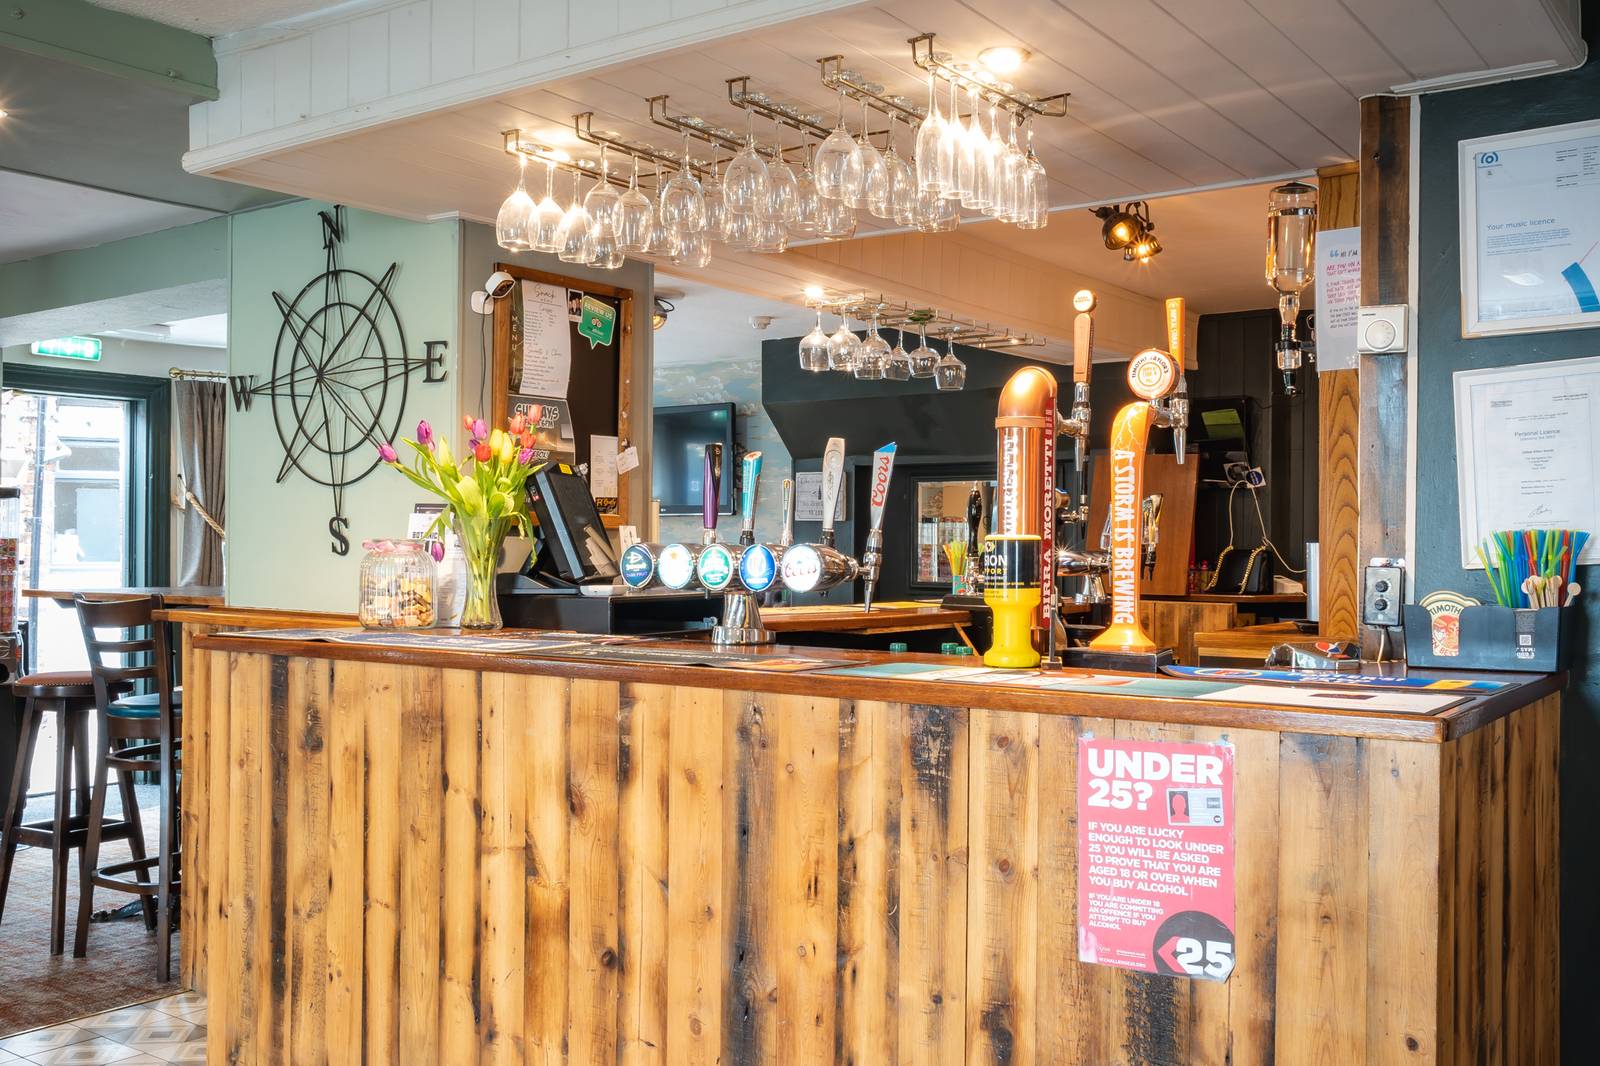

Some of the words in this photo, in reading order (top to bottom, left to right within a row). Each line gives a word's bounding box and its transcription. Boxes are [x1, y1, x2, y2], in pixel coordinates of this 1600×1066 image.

[318, 204, 343, 250] N
[1505, 221, 1527, 229] music
[1529, 217, 1555, 226] licence
[584, 302, 604, 316] REVIEW
[605, 311, 613, 320] US
[423, 341, 448, 383] E
[229, 376, 253, 412] W
[515, 403, 559, 421] SUAYS
[871, 455, 890, 508] Coors
[1043, 438, 1053, 541] MORETTI
[1114, 462, 1136, 522] STORM
[329, 516, 349, 556] S
[412, 531, 438, 539] BOTIC
[1114, 527, 1135, 543] IS
[1043, 548, 1052, 619] BIRRA
[1113, 548, 1135, 624] BREWING
[1429, 604, 1462, 616] TIMOTH
[1088, 748, 1224, 785] UNDER
[1088, 778, 1153, 811] 25?
[1088, 821, 1098, 830] IF
[1100, 822, 1122, 833] YOU
[1124, 825, 1146, 835] ARE
[1148, 827, 1184, 839] LUCKY
[1088, 832, 1133, 845] ENOUGH
[1135, 836, 1150, 847] TO
[1152, 838, 1182, 850] LOOK
[1185, 841, 1224, 854] UNDER
[1088, 843, 1101, 853] 25
[1103, 844, 1125, 855] YOU
[1127, 847, 1154, 858] WILL
[1156, 850, 1170, 860] BE
[1172, 851, 1210, 864] ASKED
[1089, 854, 1103, 864] TO
[1105, 855, 1141, 868] PROVE
[1143, 859, 1170, 871] THAT
[1172, 862, 1196, 874] YOU
[1198, 865, 1221, 877] ARE
[1089, 865, 1118, 877] AGED
[1120, 868, 1131, 878] 18
[1132, 869, 1148, 880] OR
[1150, 871, 1181, 884] OVER
[1182, 875, 1218, 888] WHEN
[1089, 875, 1112, 887] YOU
[1113, 877, 1135, 889] BUY
[1137, 880, 1189, 897] ALCOHOL
[1088, 892, 1096, 900] IF
[1096, 893, 1111, 902] YOU
[1112, 894, 1127, 904] ARE
[1127, 896, 1153, 907] UNDER
[1089, 899, 1104, 908] YOU
[1104, 900, 1119, 910] ARE
[1120, 902, 1164, 916] COMMITTING
[1089, 906, 1100, 914] AN
[1100, 907, 1132, 919] OFFENCE
[1133, 911, 1140, 919] IF
[1141, 912, 1156, 921] YOU
[1089, 914, 1121, 925] ATTEMPT
[1121, 917, 1132, 925] TO
[1132, 918, 1147, 927] BUY
[1089, 920, 1121, 931] ALCOHOL
[1176, 937, 1235, 982] 25
